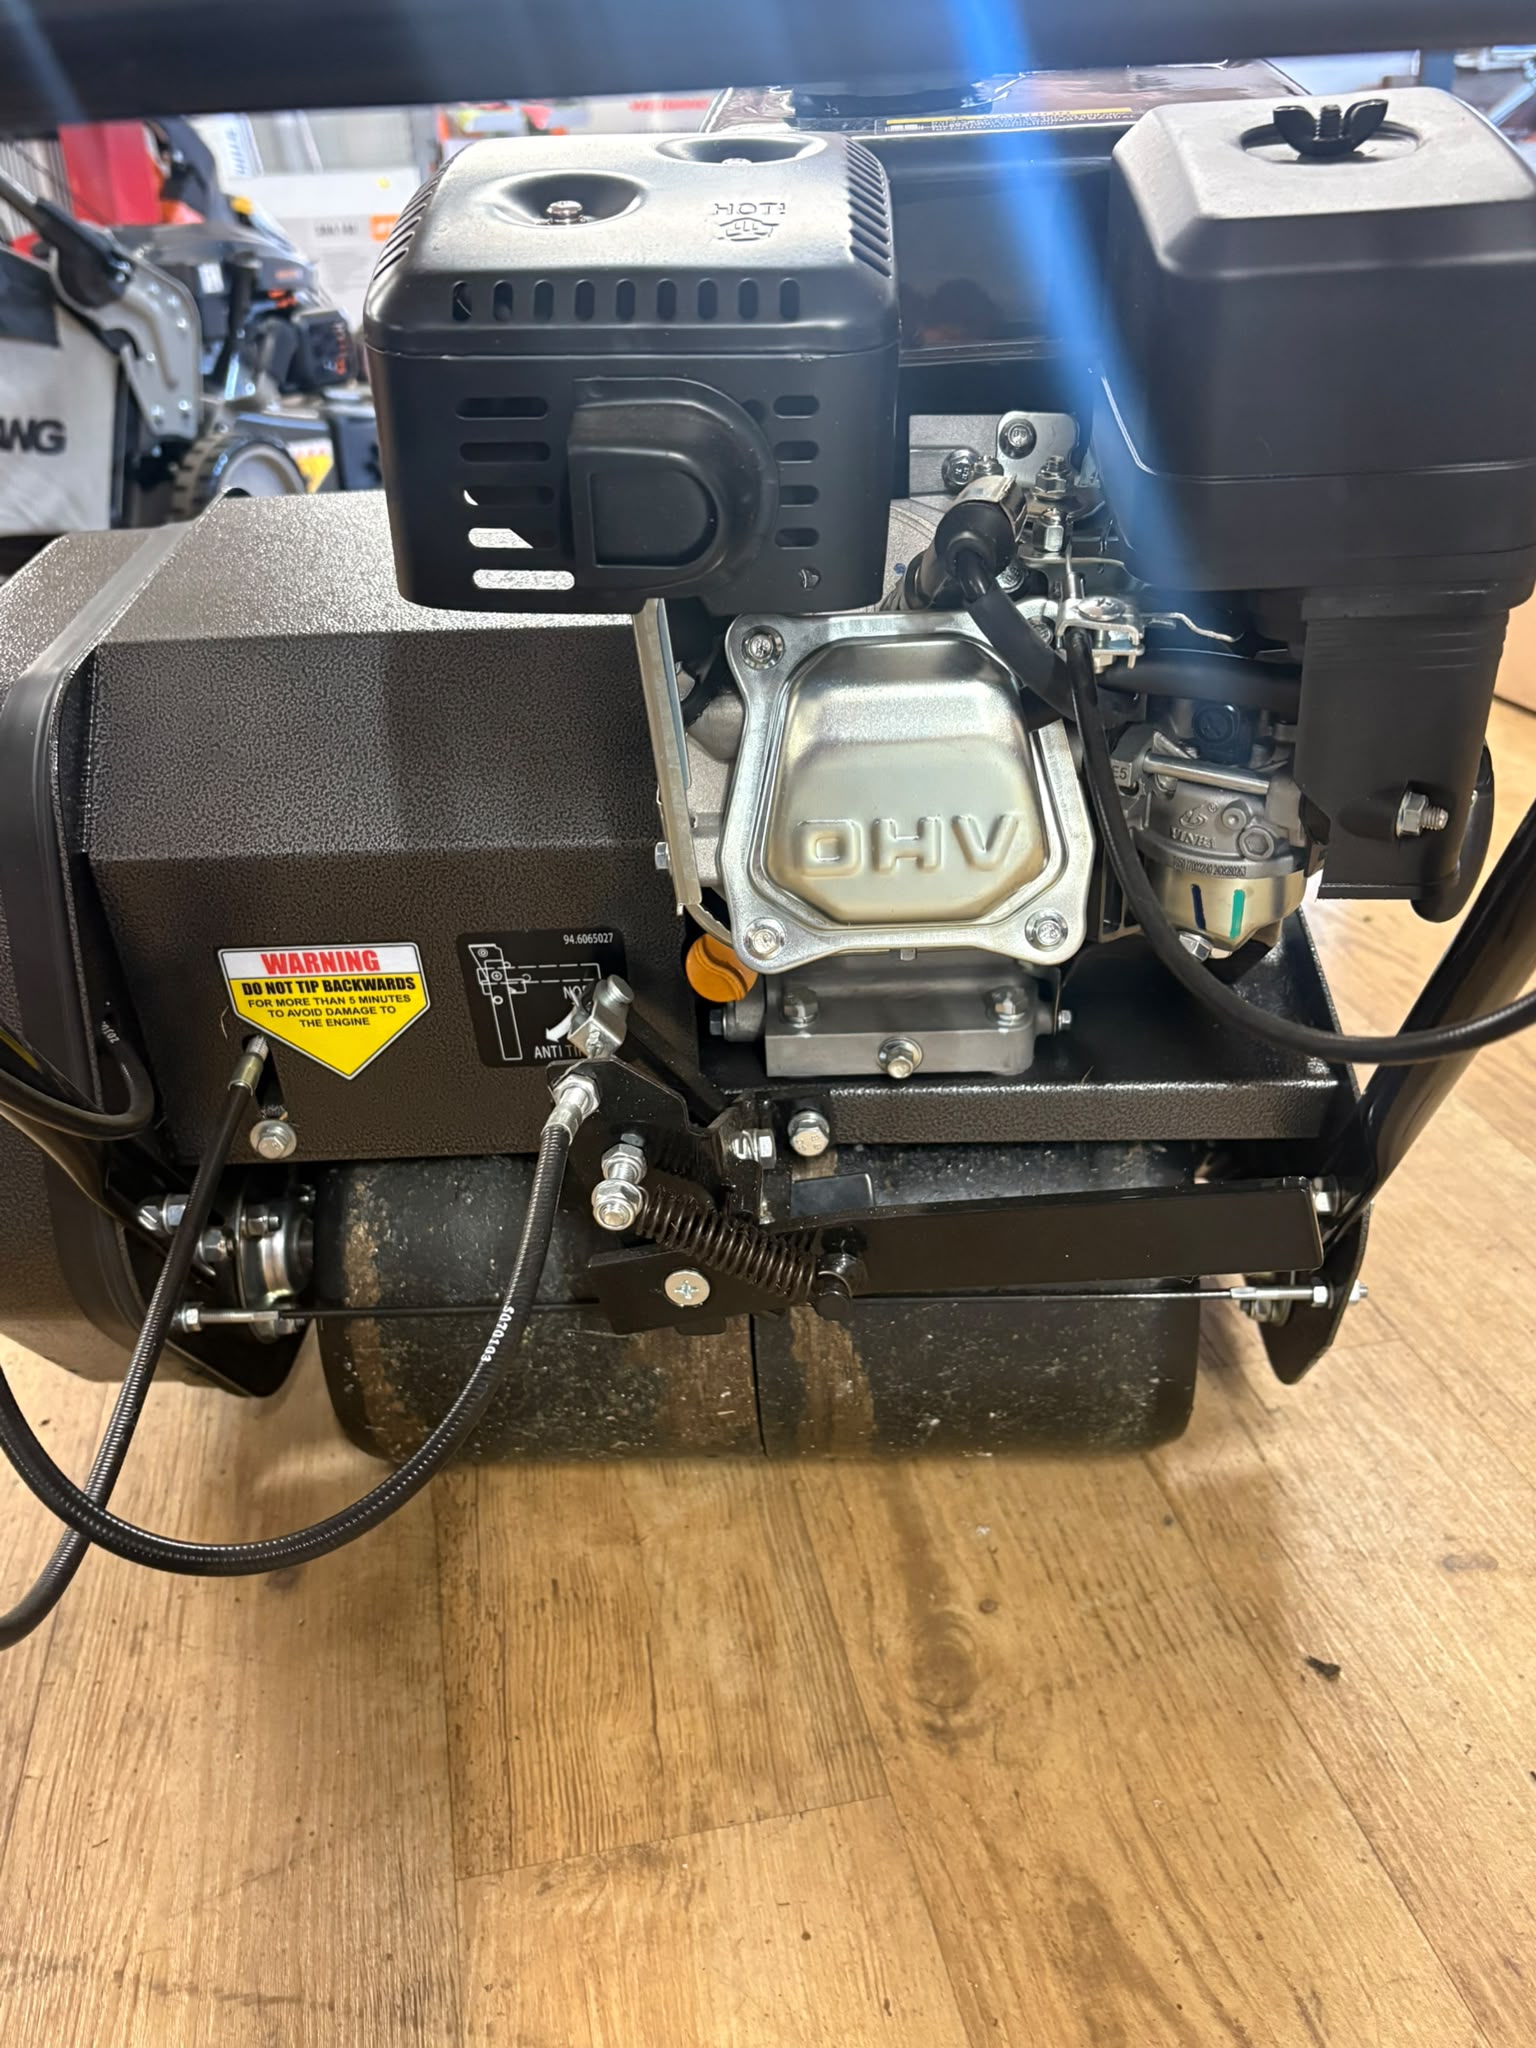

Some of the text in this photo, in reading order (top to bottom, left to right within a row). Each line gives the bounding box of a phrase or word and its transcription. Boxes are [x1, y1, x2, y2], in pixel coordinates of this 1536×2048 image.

[711, 202, 786, 216] HOT!
[793, 813, 1022, 878] OHV
[563, 932, 614, 945] 94.6065027
[260, 949, 381, 975] WARNING
[242, 976, 416, 996] DO NOT TIP BACKWARDS
[248, 994, 411, 1008] FOR MORE THAN 5 MINUTES
[267, 1005, 396, 1018] TO AVOID DAMAGE TO
[299, 1017, 370, 1028] THE ENGINE
[534, 1045, 562, 1059] ANTI
[480, 1305, 515, 1362] S070103
